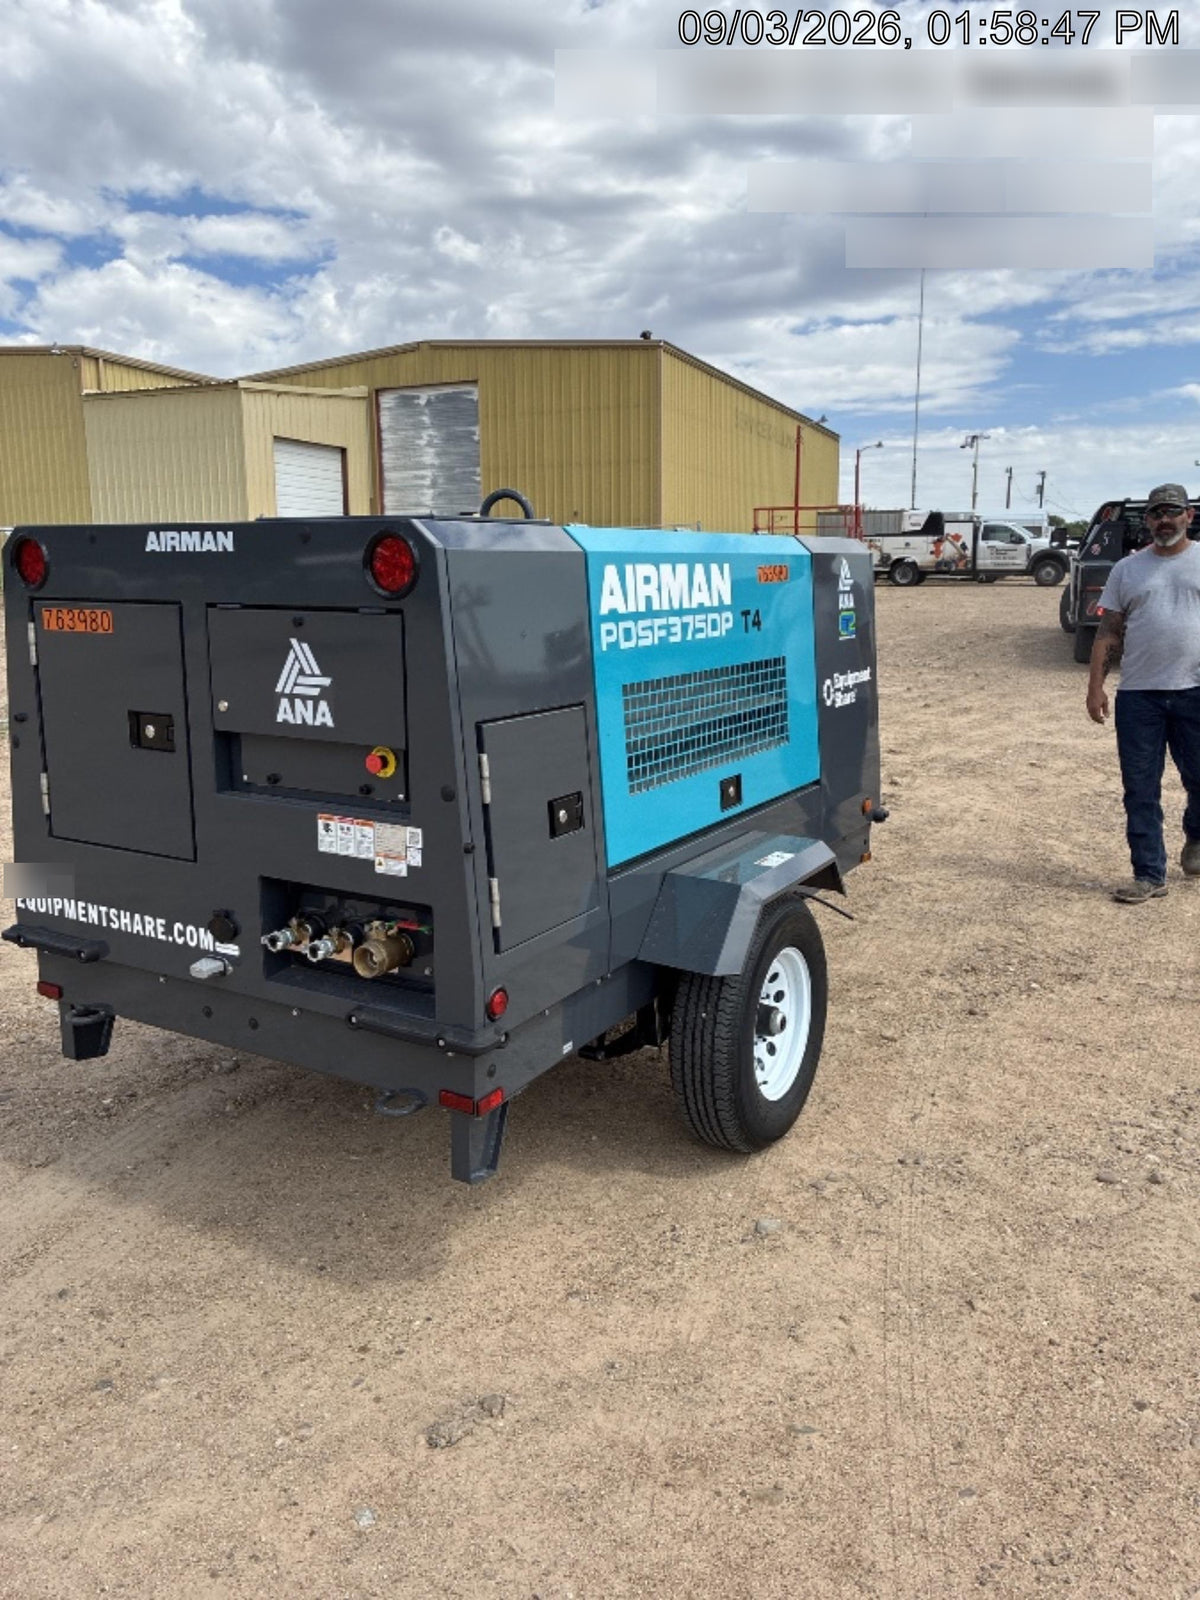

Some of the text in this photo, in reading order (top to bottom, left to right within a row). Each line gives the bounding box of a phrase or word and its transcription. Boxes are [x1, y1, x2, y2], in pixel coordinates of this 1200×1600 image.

[145, 531, 234, 552] AIRMAN
[599, 563, 732, 615] AIRMAN
[44, 607, 112, 632] 763980
[600, 609, 762, 651] PDSF375DP T4
[276, 697, 335, 728] ANA
[17, 897, 214, 952] EQUIPMENTSHARE.COM
